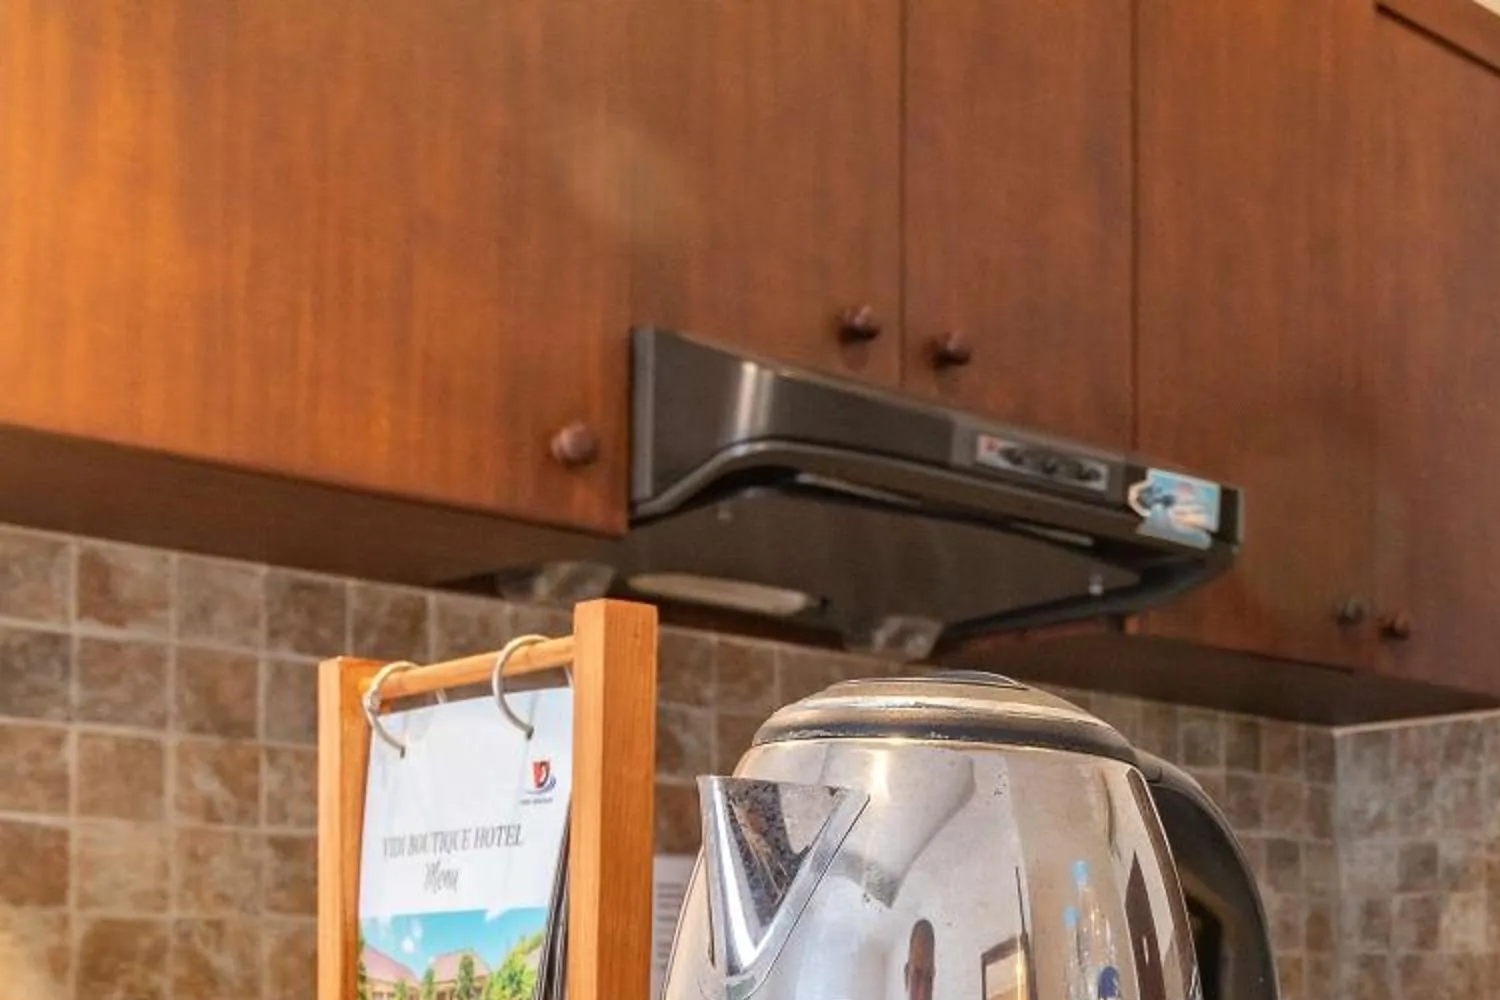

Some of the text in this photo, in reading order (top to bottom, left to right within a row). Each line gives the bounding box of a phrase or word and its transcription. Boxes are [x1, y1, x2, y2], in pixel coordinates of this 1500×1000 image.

[407, 828, 471, 857] BOUTIQUE
[474, 823, 523, 849] HOTEL
[423, 860, 460, 894] Menu
